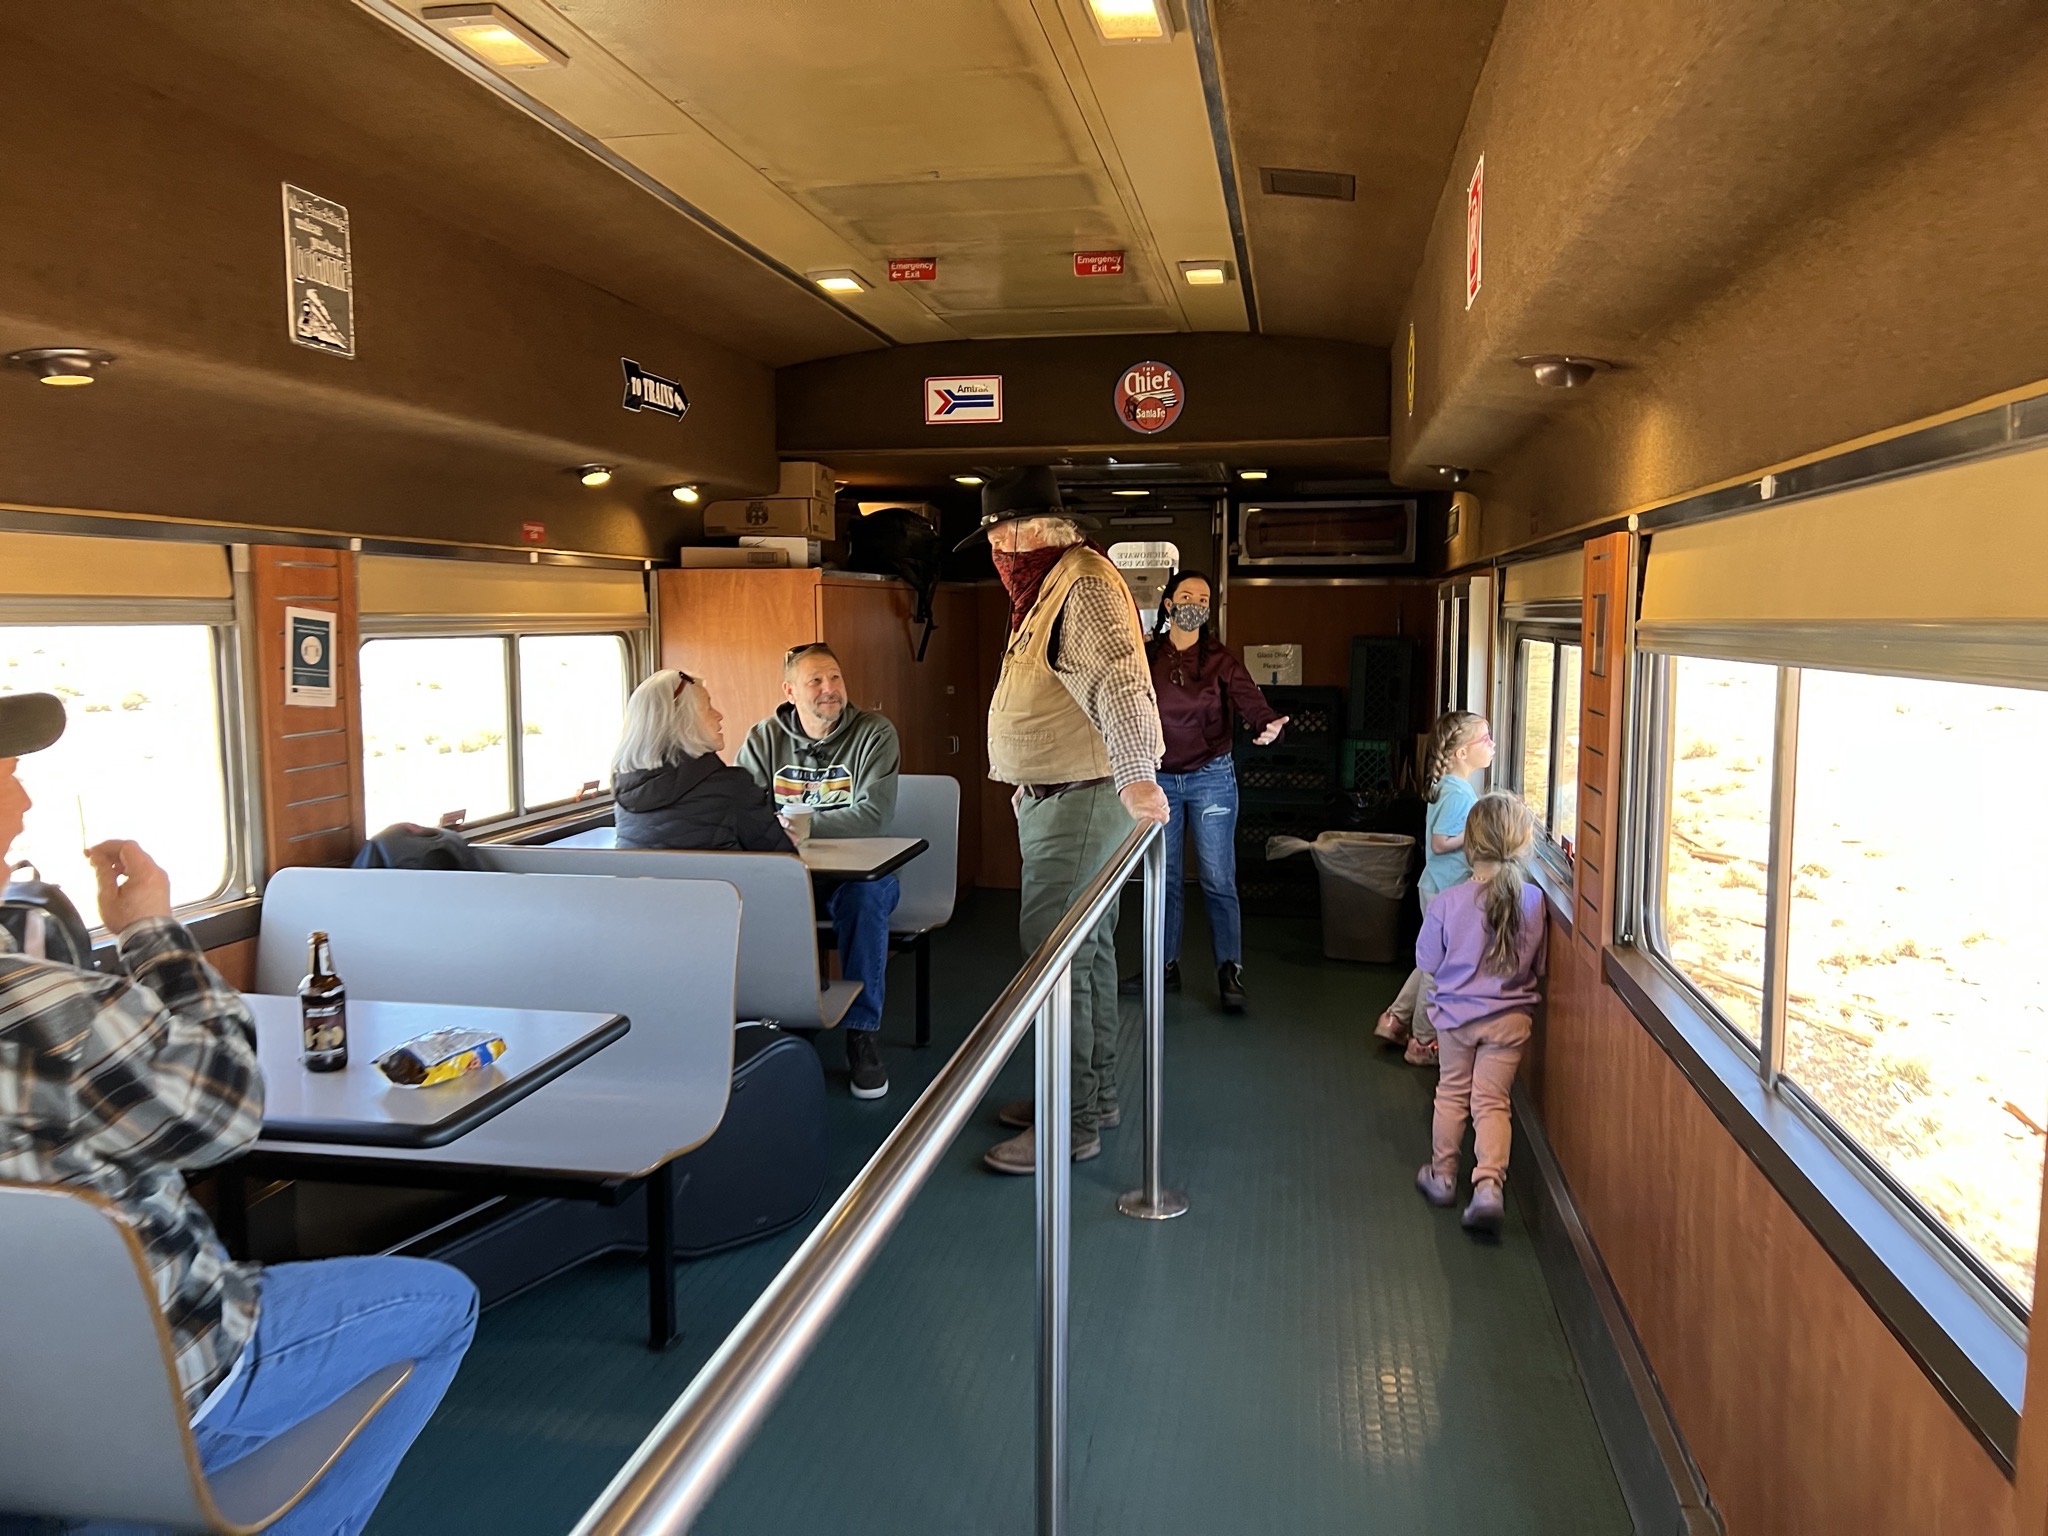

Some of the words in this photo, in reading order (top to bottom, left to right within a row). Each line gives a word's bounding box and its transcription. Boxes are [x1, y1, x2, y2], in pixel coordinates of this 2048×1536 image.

[1077, 255, 1122, 265] Emergency
[891, 262, 934, 271] Emergency
[1091, 264, 1107, 273] Exit
[904, 270, 920, 278] Exit
[1124, 370, 1172, 396] Chief
[630, 376, 642, 397] TO
[642, 377, 675, 410] TRAINS
